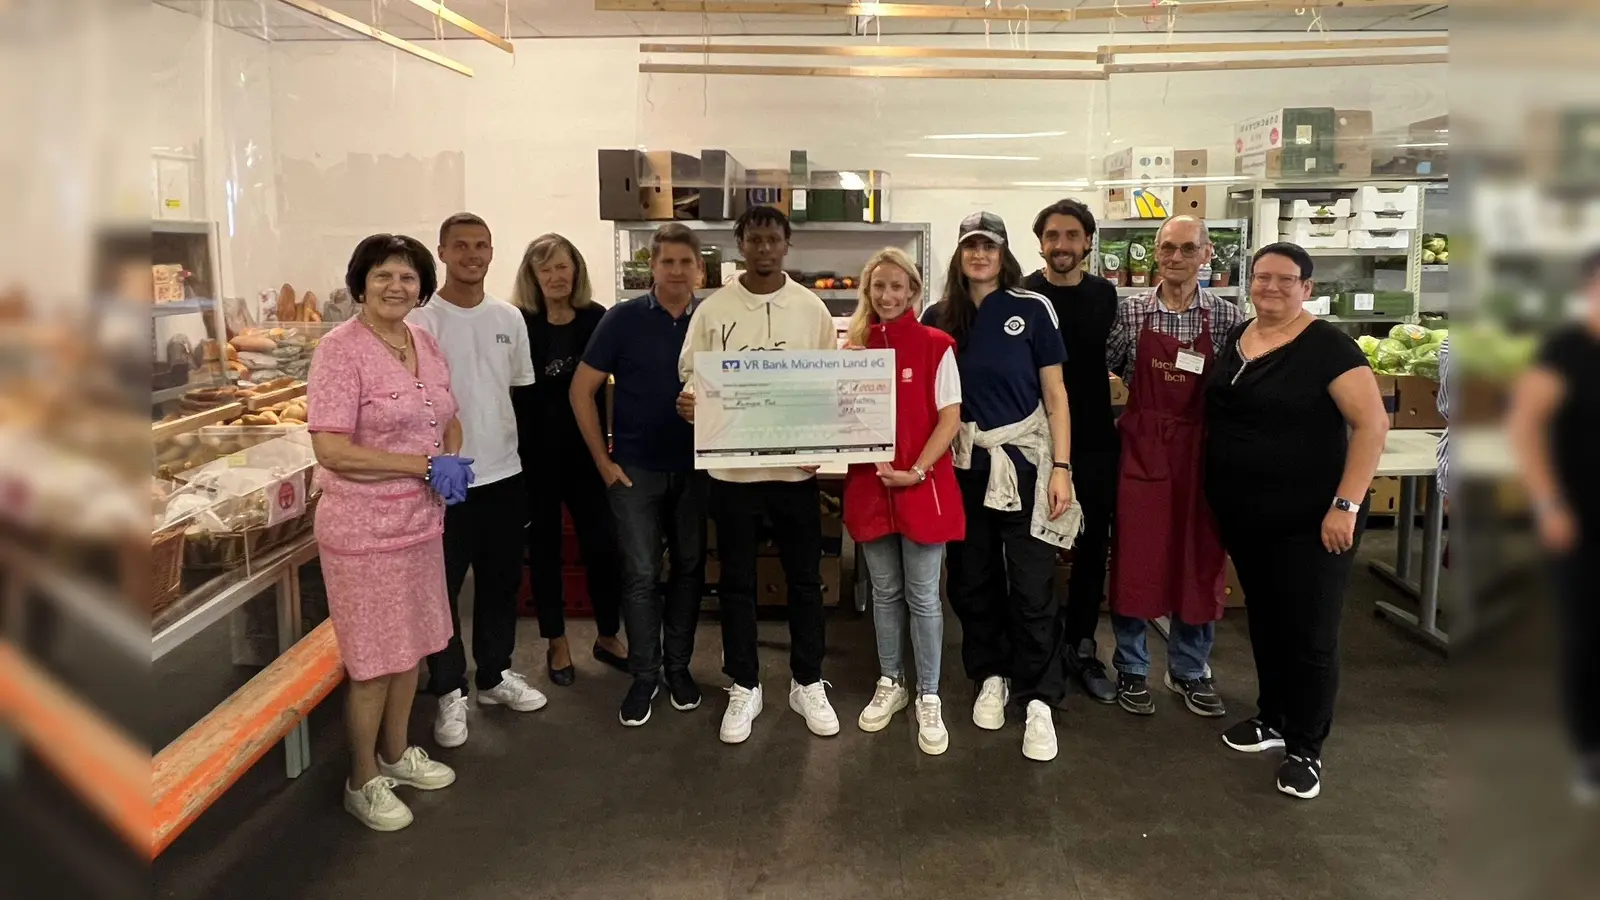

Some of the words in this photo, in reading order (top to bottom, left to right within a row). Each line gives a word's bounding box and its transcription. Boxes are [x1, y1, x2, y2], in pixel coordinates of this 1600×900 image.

[744, 360, 760, 370] VR
[763, 359, 789, 370] Bank
[791, 358, 840, 369] München
[843, 358, 868, 368] Land
[870, 358, 885, 368] eG
